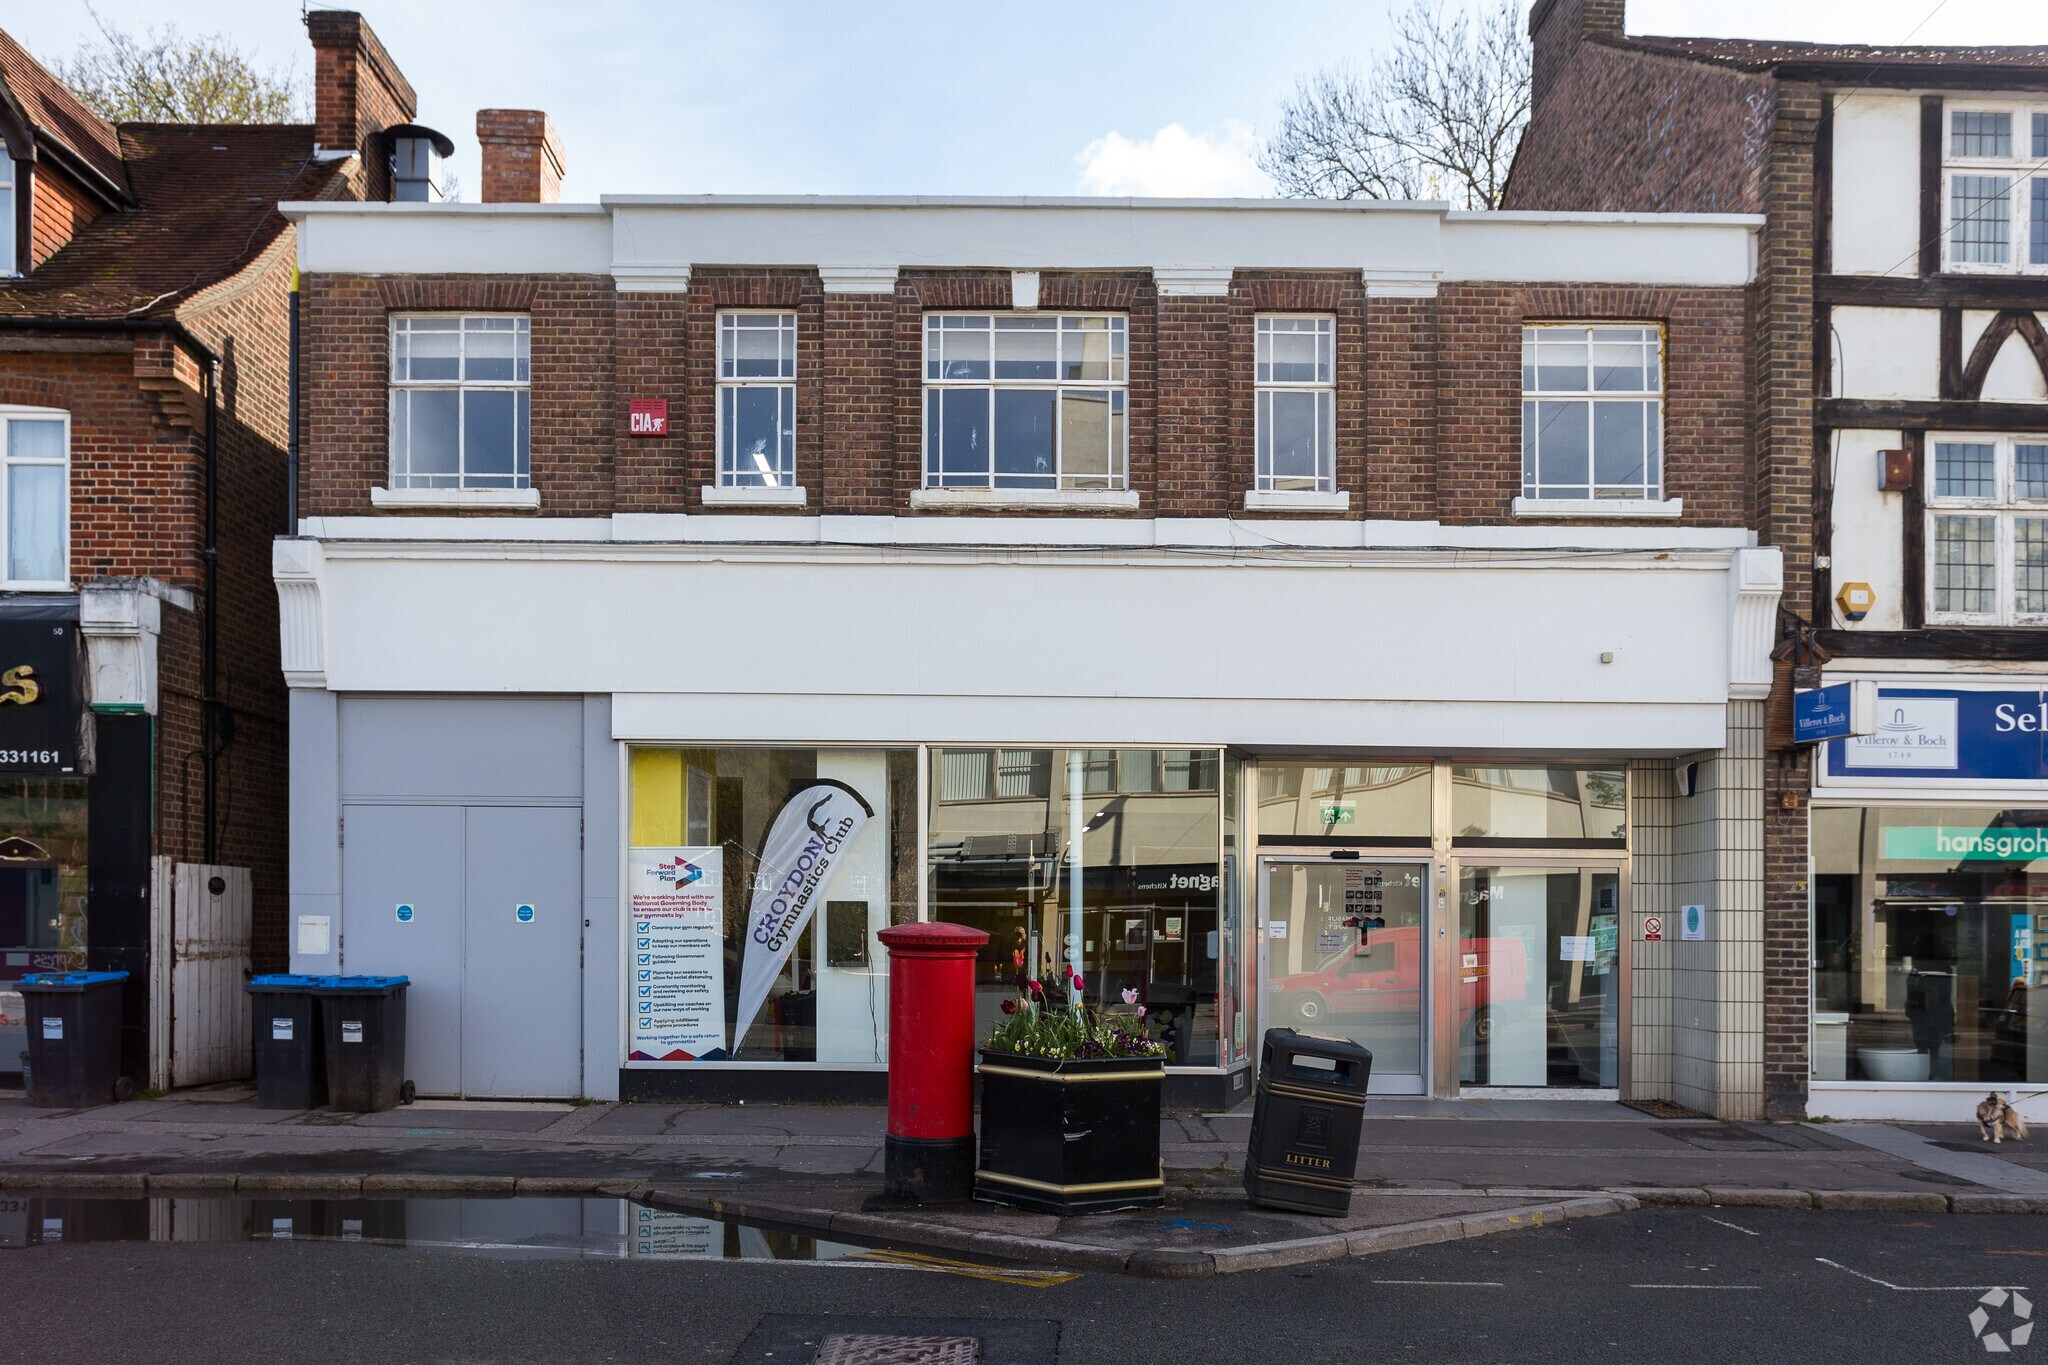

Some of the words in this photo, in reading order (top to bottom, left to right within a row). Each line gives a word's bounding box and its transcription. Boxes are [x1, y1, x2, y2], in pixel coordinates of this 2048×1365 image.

[631, 413, 652, 432] CIA
[1799, 718, 1822, 729] Villeroy
[1829, 712, 1846, 724] Boch
[1856, 734, 1898, 748] Villeroy
[1904, 734, 1913, 746] &
[1918, 734, 1946, 746] Boch
[0, 750, 59, 763] 331161
[1936, 827, 2048, 857] hansgroh
[753, 837, 824, 944] CROYDON
[767, 858, 829, 952] Gymnastics
[825, 817, 854, 854] Club
[1286, 1154, 1331, 1168] LITTER
